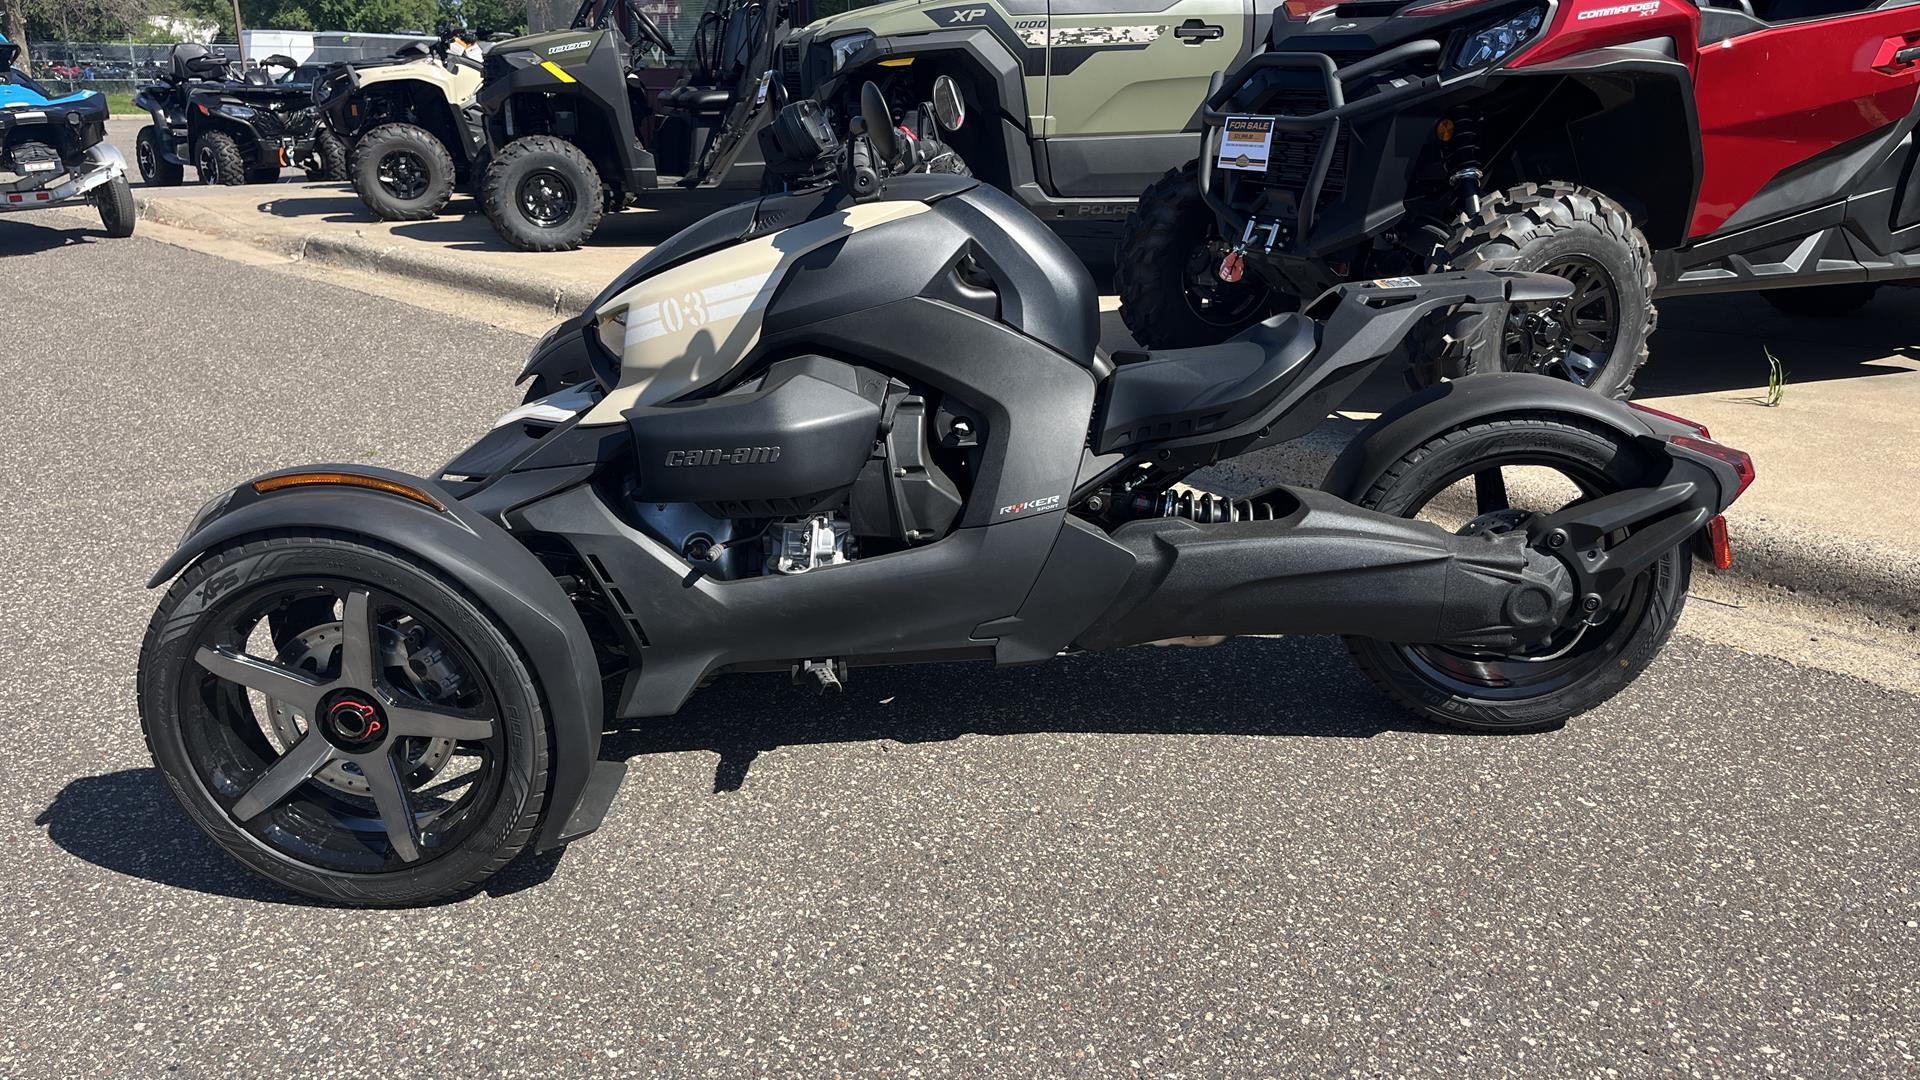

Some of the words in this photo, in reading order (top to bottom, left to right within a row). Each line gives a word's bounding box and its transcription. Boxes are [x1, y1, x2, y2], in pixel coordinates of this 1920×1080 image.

[949, 9, 987, 23] XP
[1577, 1, 1660, 20] COMMANDER
[1639, 9, 1658, 17] XT
[1014, 20, 1047, 29] 1000
[548, 40, 591, 55] 1000
[1230, 121, 1246, 129] FOR
[1247, 122, 1270, 130] SALE
[663, 291, 706, 333] 03
[665, 446, 780, 467] can-am
[1000, 495, 1060, 515] RYKER
[1037, 503, 1059, 512] SPORT
[195, 567, 240, 608] XPS
